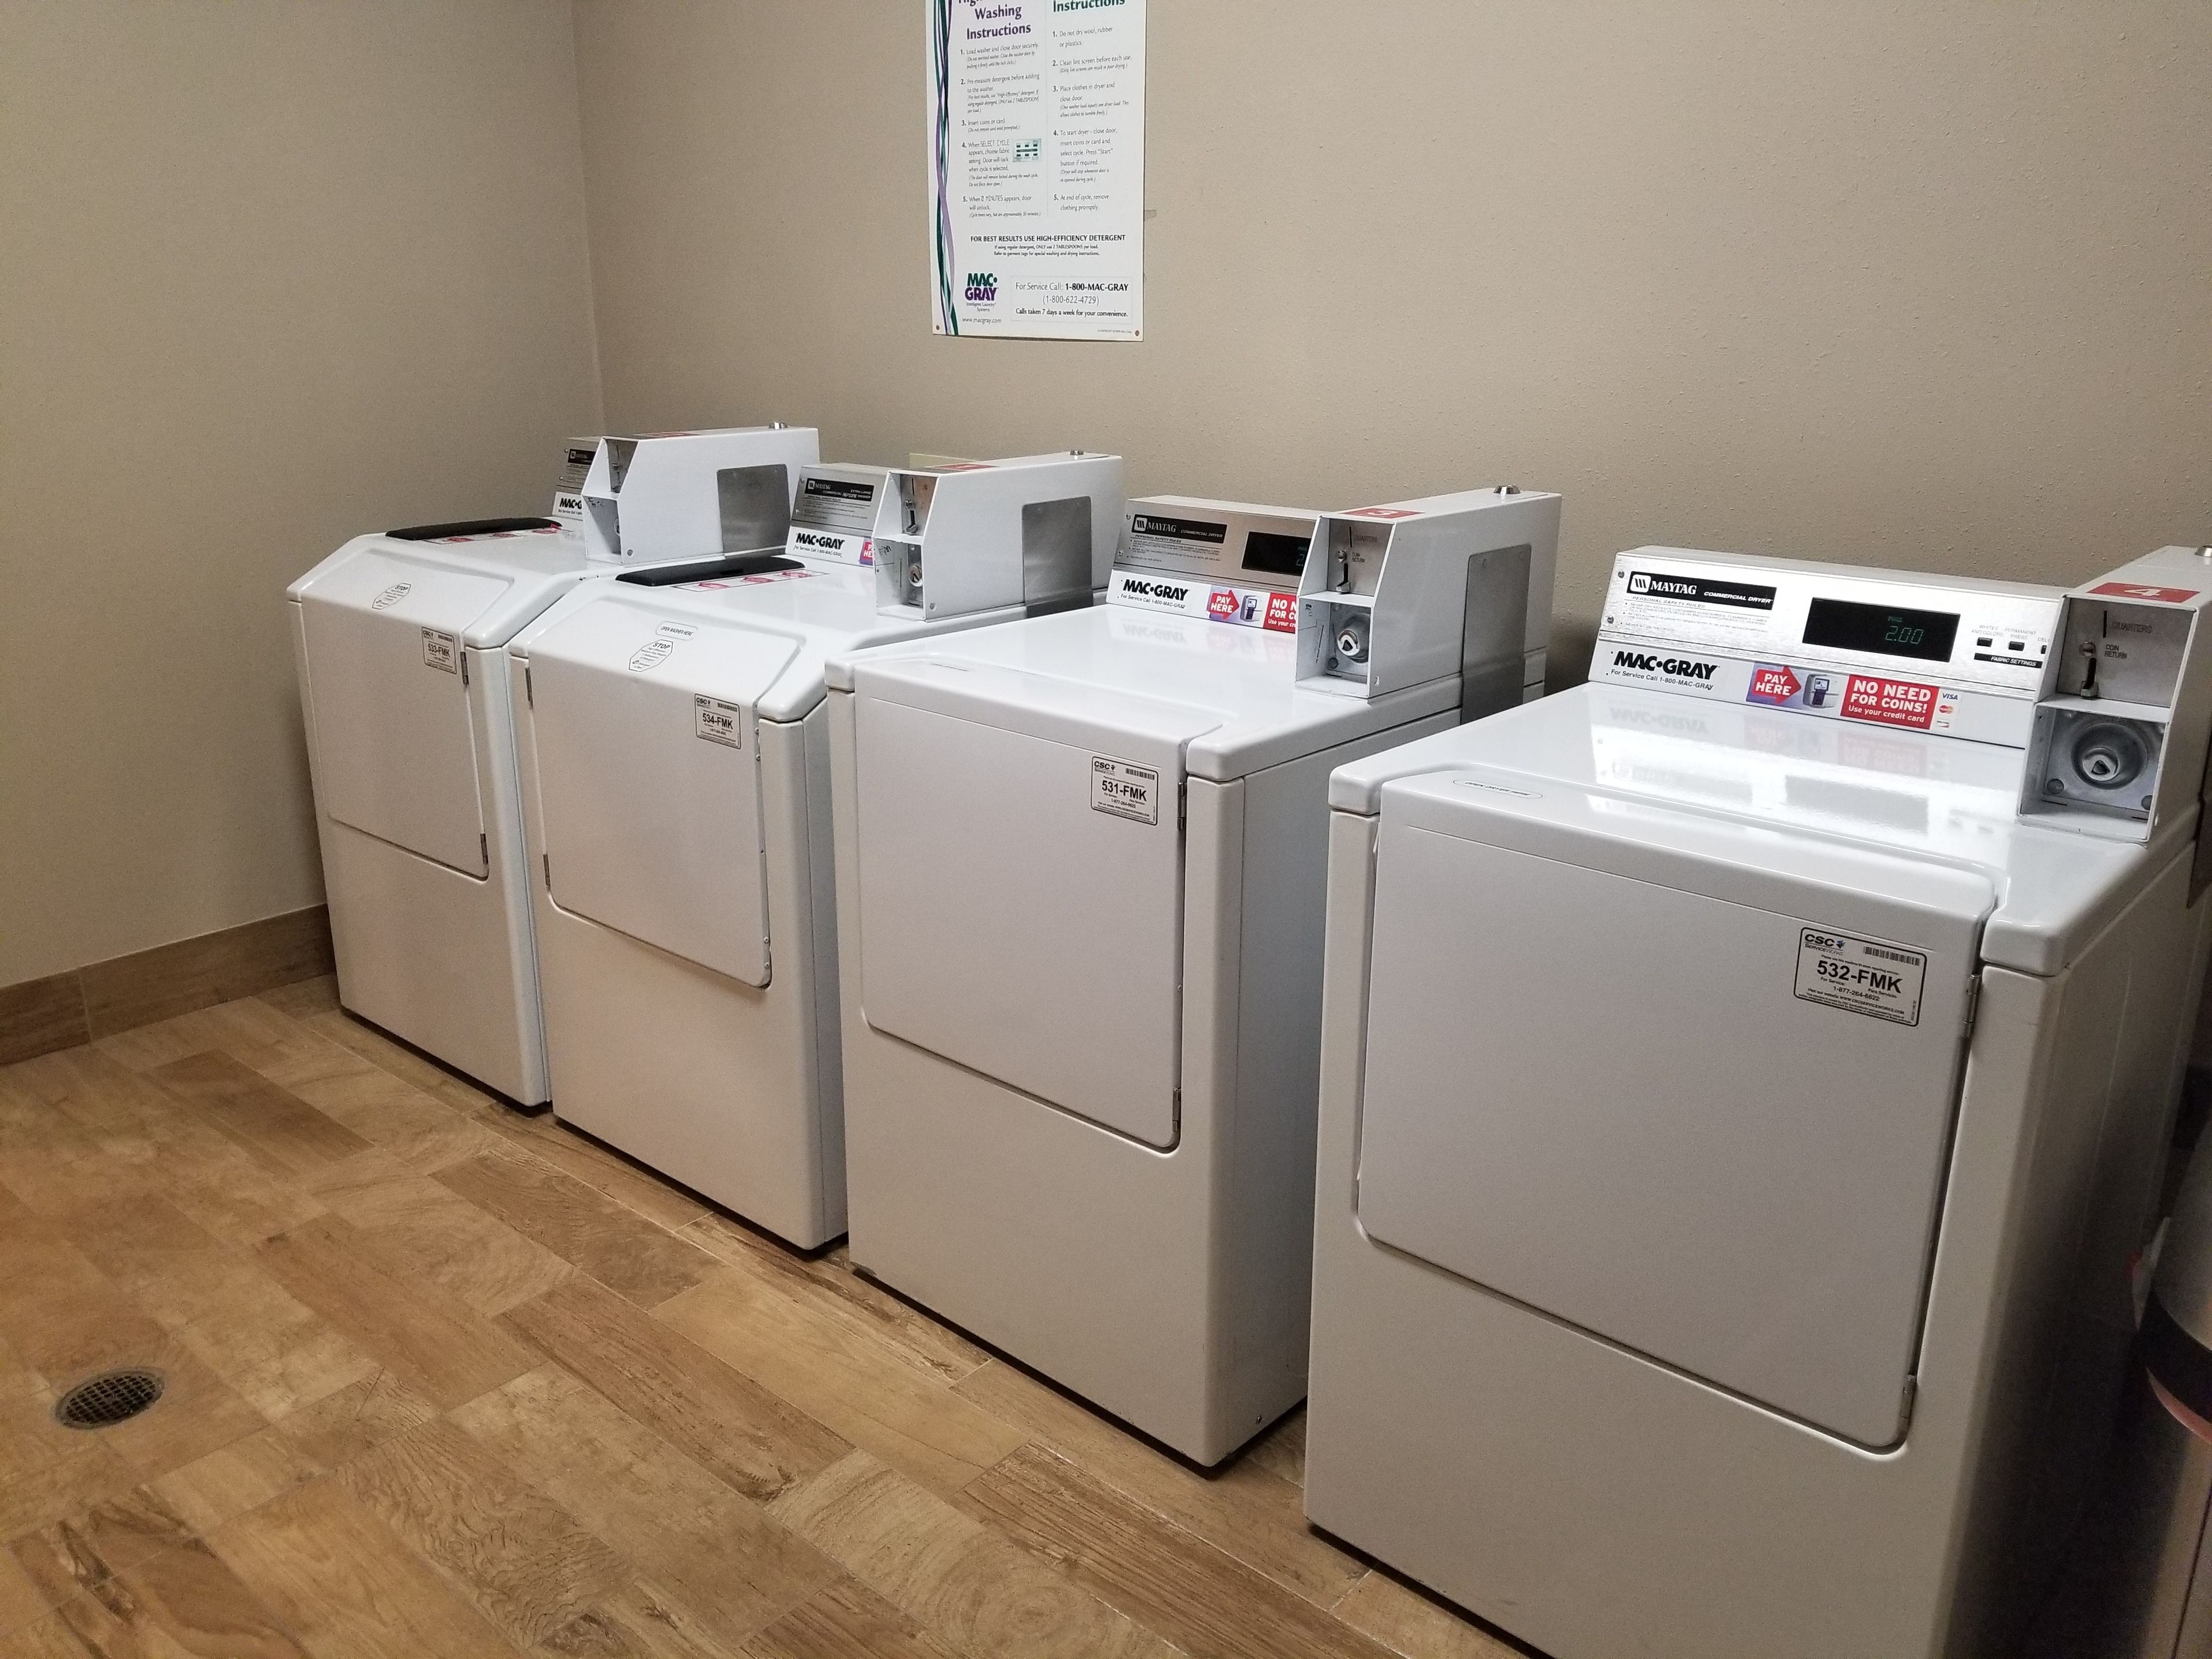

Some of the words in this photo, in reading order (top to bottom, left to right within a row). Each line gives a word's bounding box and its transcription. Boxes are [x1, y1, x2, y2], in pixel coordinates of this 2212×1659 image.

[975, 4, 1022, 20] Washing
[967, 22, 1031, 40] Instructions
[1050, 282, 1063, 290] Call:
[965, 287, 997, 301] GRAY
[1043, 295, 1099, 306] (1-800-622-4729)
[1047, 309, 1057, 317] days
[1147, 522, 1176, 533] MAYTAG
[1650, 580, 1697, 595] MAYTAG
[1703, 591, 1747, 601] COMMERCIAL
[1152, 599, 1185, 609] 1-800-MAC-GRAY
[1216, 596, 1232, 604] PAY
[1272, 599, 1287, 609] NO
[1211, 603, 1233, 613] HERE
[1270, 609, 1286, 618] FOR
[1885, 626, 1923, 645] 2.00
[1622, 671, 1645, 680] Service
[1659, 676, 1714, 690] 1-800-MAC-GRAY
[1764, 673, 1788, 685] PAY
[1756, 681, 1792, 696] HERE
[1853, 680, 1878, 694] NO
[1883, 684, 1931, 702] NEED
[1850, 694, 1877, 706] FOR
[1881, 698, 1928, 713] COINS!
[1848, 704, 1862, 713] Use
[1864, 708, 1882, 716] your
[1883, 710, 1906, 719] credit
[703, 713, 733, 730] 534-FMK
[1094, 761, 1110, 770] CSC
[1101, 780, 1147, 802] 531-FMK
[1805, 934, 1835, 947] CSC
[1817, 960, 1903, 994] 532-FMK
[1833, 986, 1880, 1001] 1-877-264-6622
